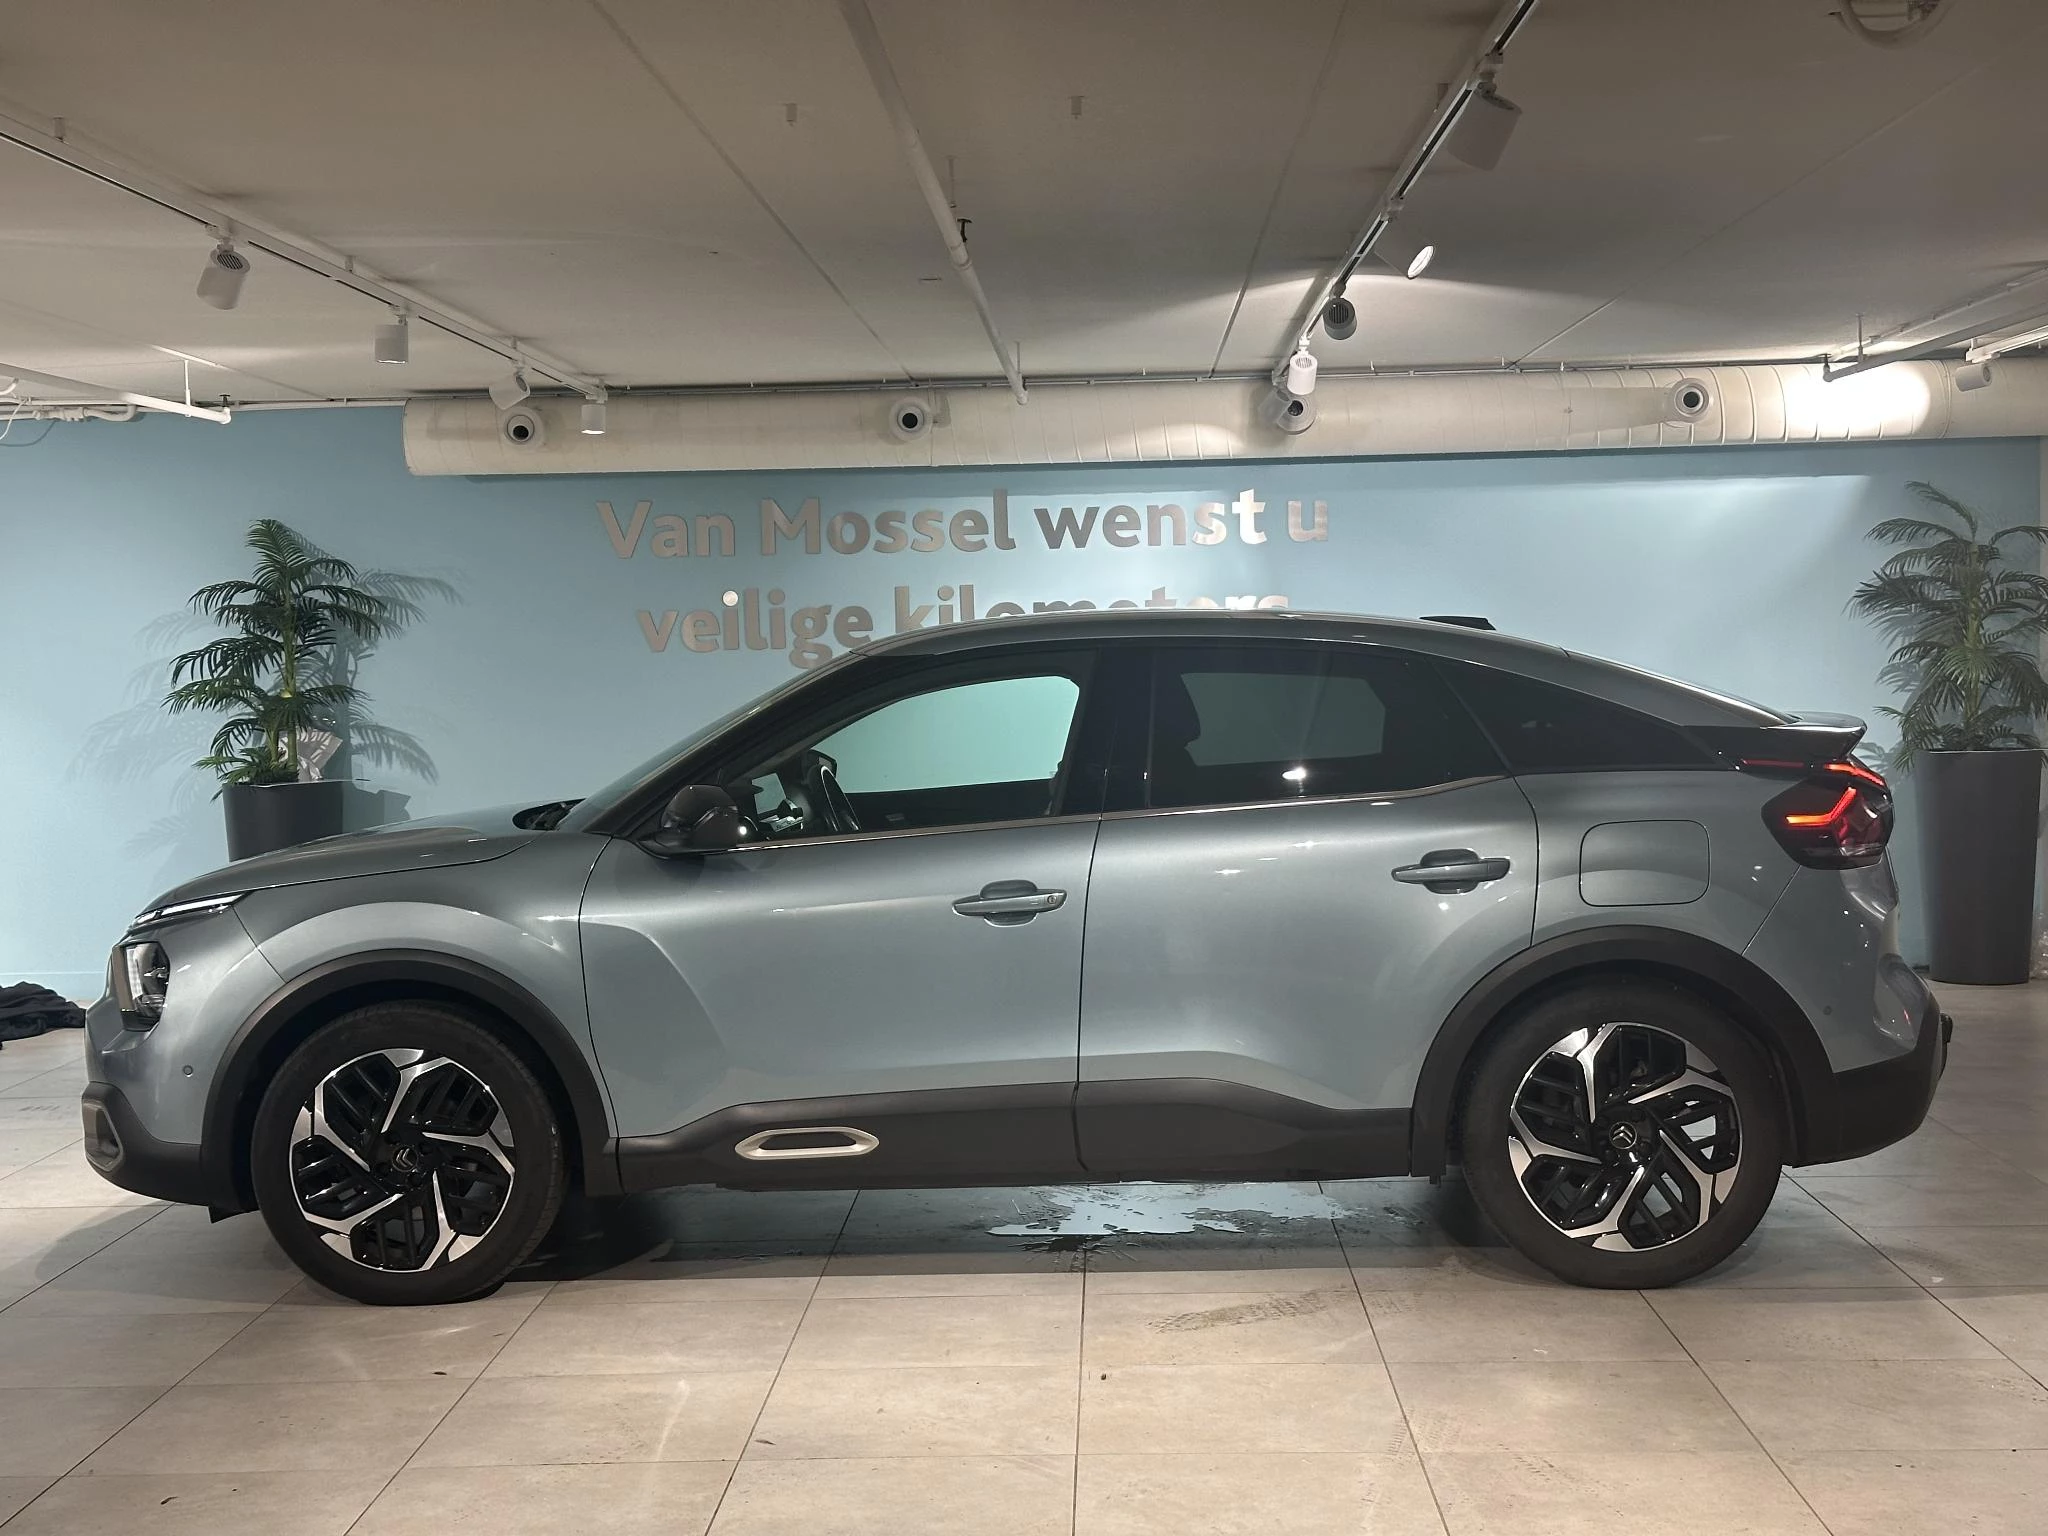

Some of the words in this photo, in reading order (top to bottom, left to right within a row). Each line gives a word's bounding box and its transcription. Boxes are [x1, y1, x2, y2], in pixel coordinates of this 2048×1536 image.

[596, 500, 736, 559] Van
[759, 488, 1016, 555] Mossel
[1033, 488, 1268, 549] wenst
[1287, 500, 1329, 542] u
[637, 587, 874, 670] veilige
